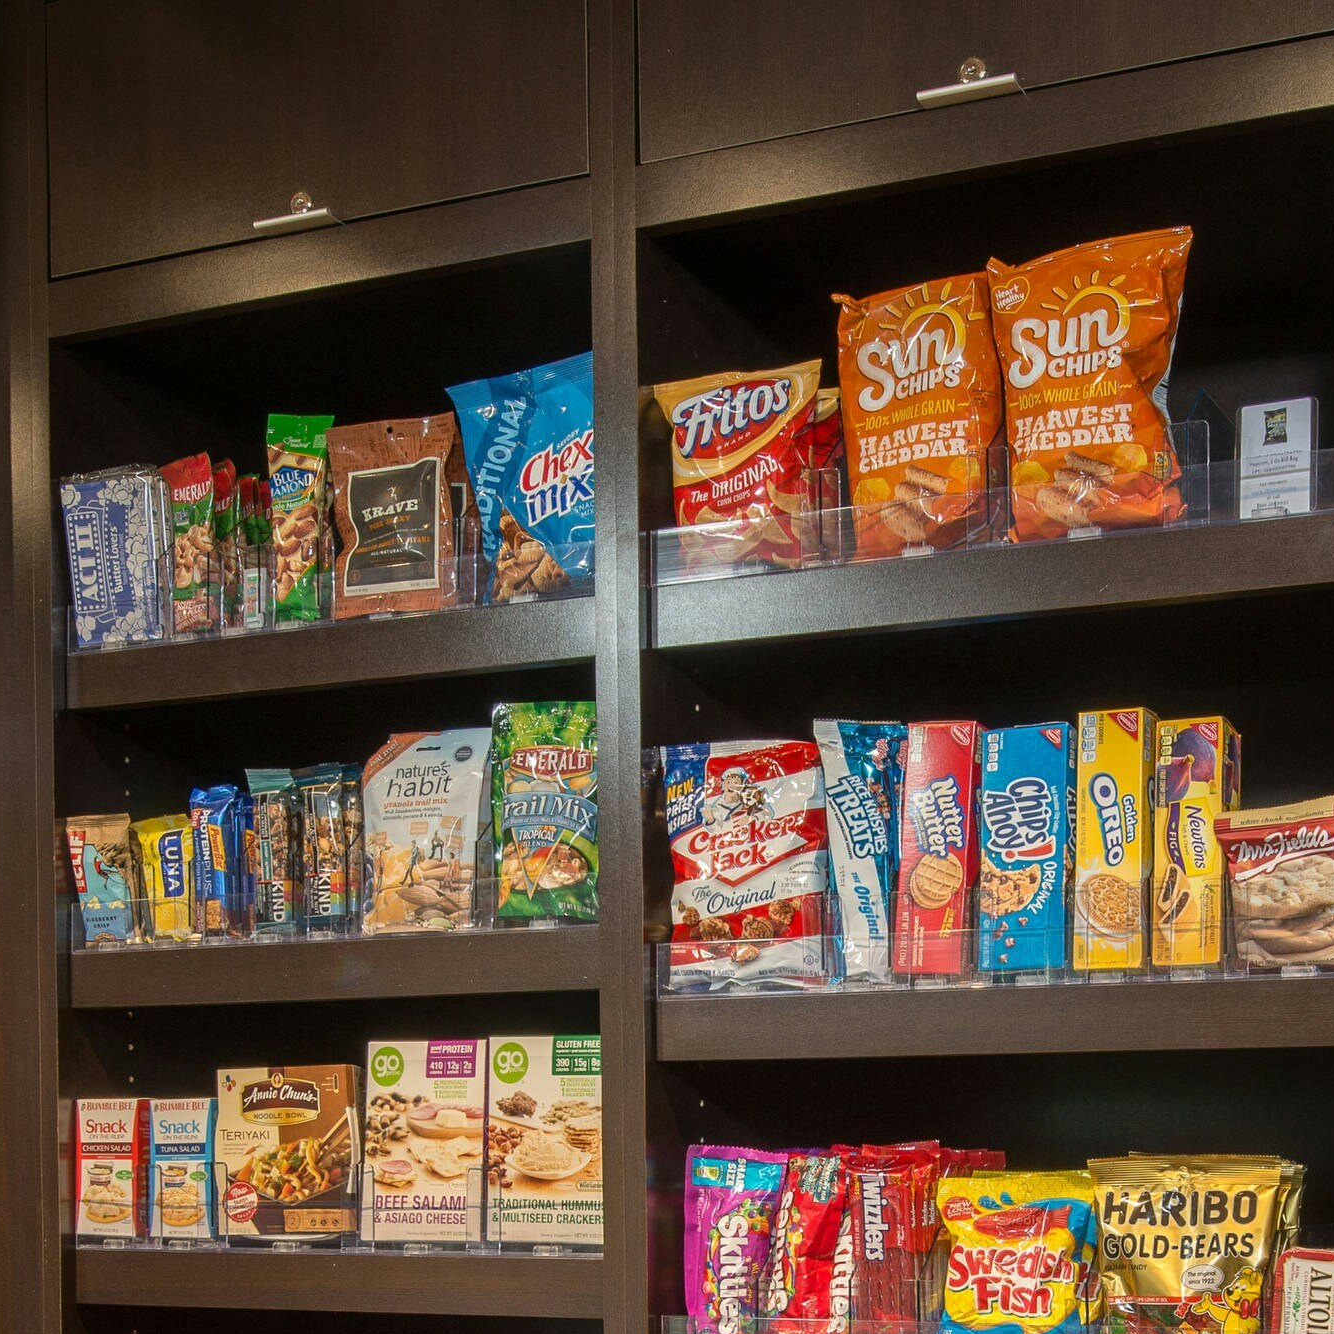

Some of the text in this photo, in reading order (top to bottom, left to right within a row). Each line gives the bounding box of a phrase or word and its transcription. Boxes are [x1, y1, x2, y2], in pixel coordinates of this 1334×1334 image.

[995, 285, 1019, 300] Heart
[996, 293, 1025, 310] Healthy
[1009, 308, 1130, 389] Sun
[857, 325, 967, 412] Sun
[1048, 348, 1123, 378] CHIPS
[896, 362, 961, 398] CHIPS
[672, 379, 791, 458] Fritos
[1014, 404, 1133, 439] HARVEST
[859, 421, 969, 454] HARVEST
[273, 470, 300, 486] BLUE
[717, 490, 751, 507] CORN CHIPS
[362, 499, 418, 522] KRAVE
[109, 526, 123, 593] Butter Lovers
[516, 752, 589, 772] EMERALD
[387, 776, 452, 797] habit
[827, 779, 874, 859] TREATS
[1090, 773, 1124, 866] OREO
[1123, 795, 1135, 843] Golden
[518, 829, 556, 841] TROPICAL
[165, 836, 179, 891] LUNA
[272, 881, 284, 922] KIND
[319, 870, 331, 915] KIND
[442, 1045, 473, 1054] PROTEIN
[556, 1040, 600, 1049] GLUTEN FREE
[430, 1062, 472, 1071] 410 12g 2g
[86, 1102, 134, 1111] BUMBLE BEE
[159, 1102, 206, 1111] BUMBLE BEE
[244, 1085, 317, 1107] Annie Chun's
[85, 1120, 127, 1133] Snack
[159, 1120, 200, 1134] Snack
[220, 1129, 270, 1141] TERIYAKI
[82, 1144, 132, 1152] CHICKEN SALAD
[180, 1145, 200, 1153] SALAD
[726, 1163, 736, 1186] SIZE
[736, 1158, 748, 1192] SHARE
[375, 1195, 466, 1210] BEEF SALAMI
[950, 1201, 972, 1210] NEW
[1103, 1190, 1258, 1226] HARIBO
[374, 1212, 466, 1225] & ASIAGO CHEESE
[860, 1173, 885, 1262] Twizzlers
[1103, 1232, 1255, 1259] GOLD-BEARS
[948, 1245, 1075, 1290] Swedish
[971, 1276, 1053, 1317] Fish
